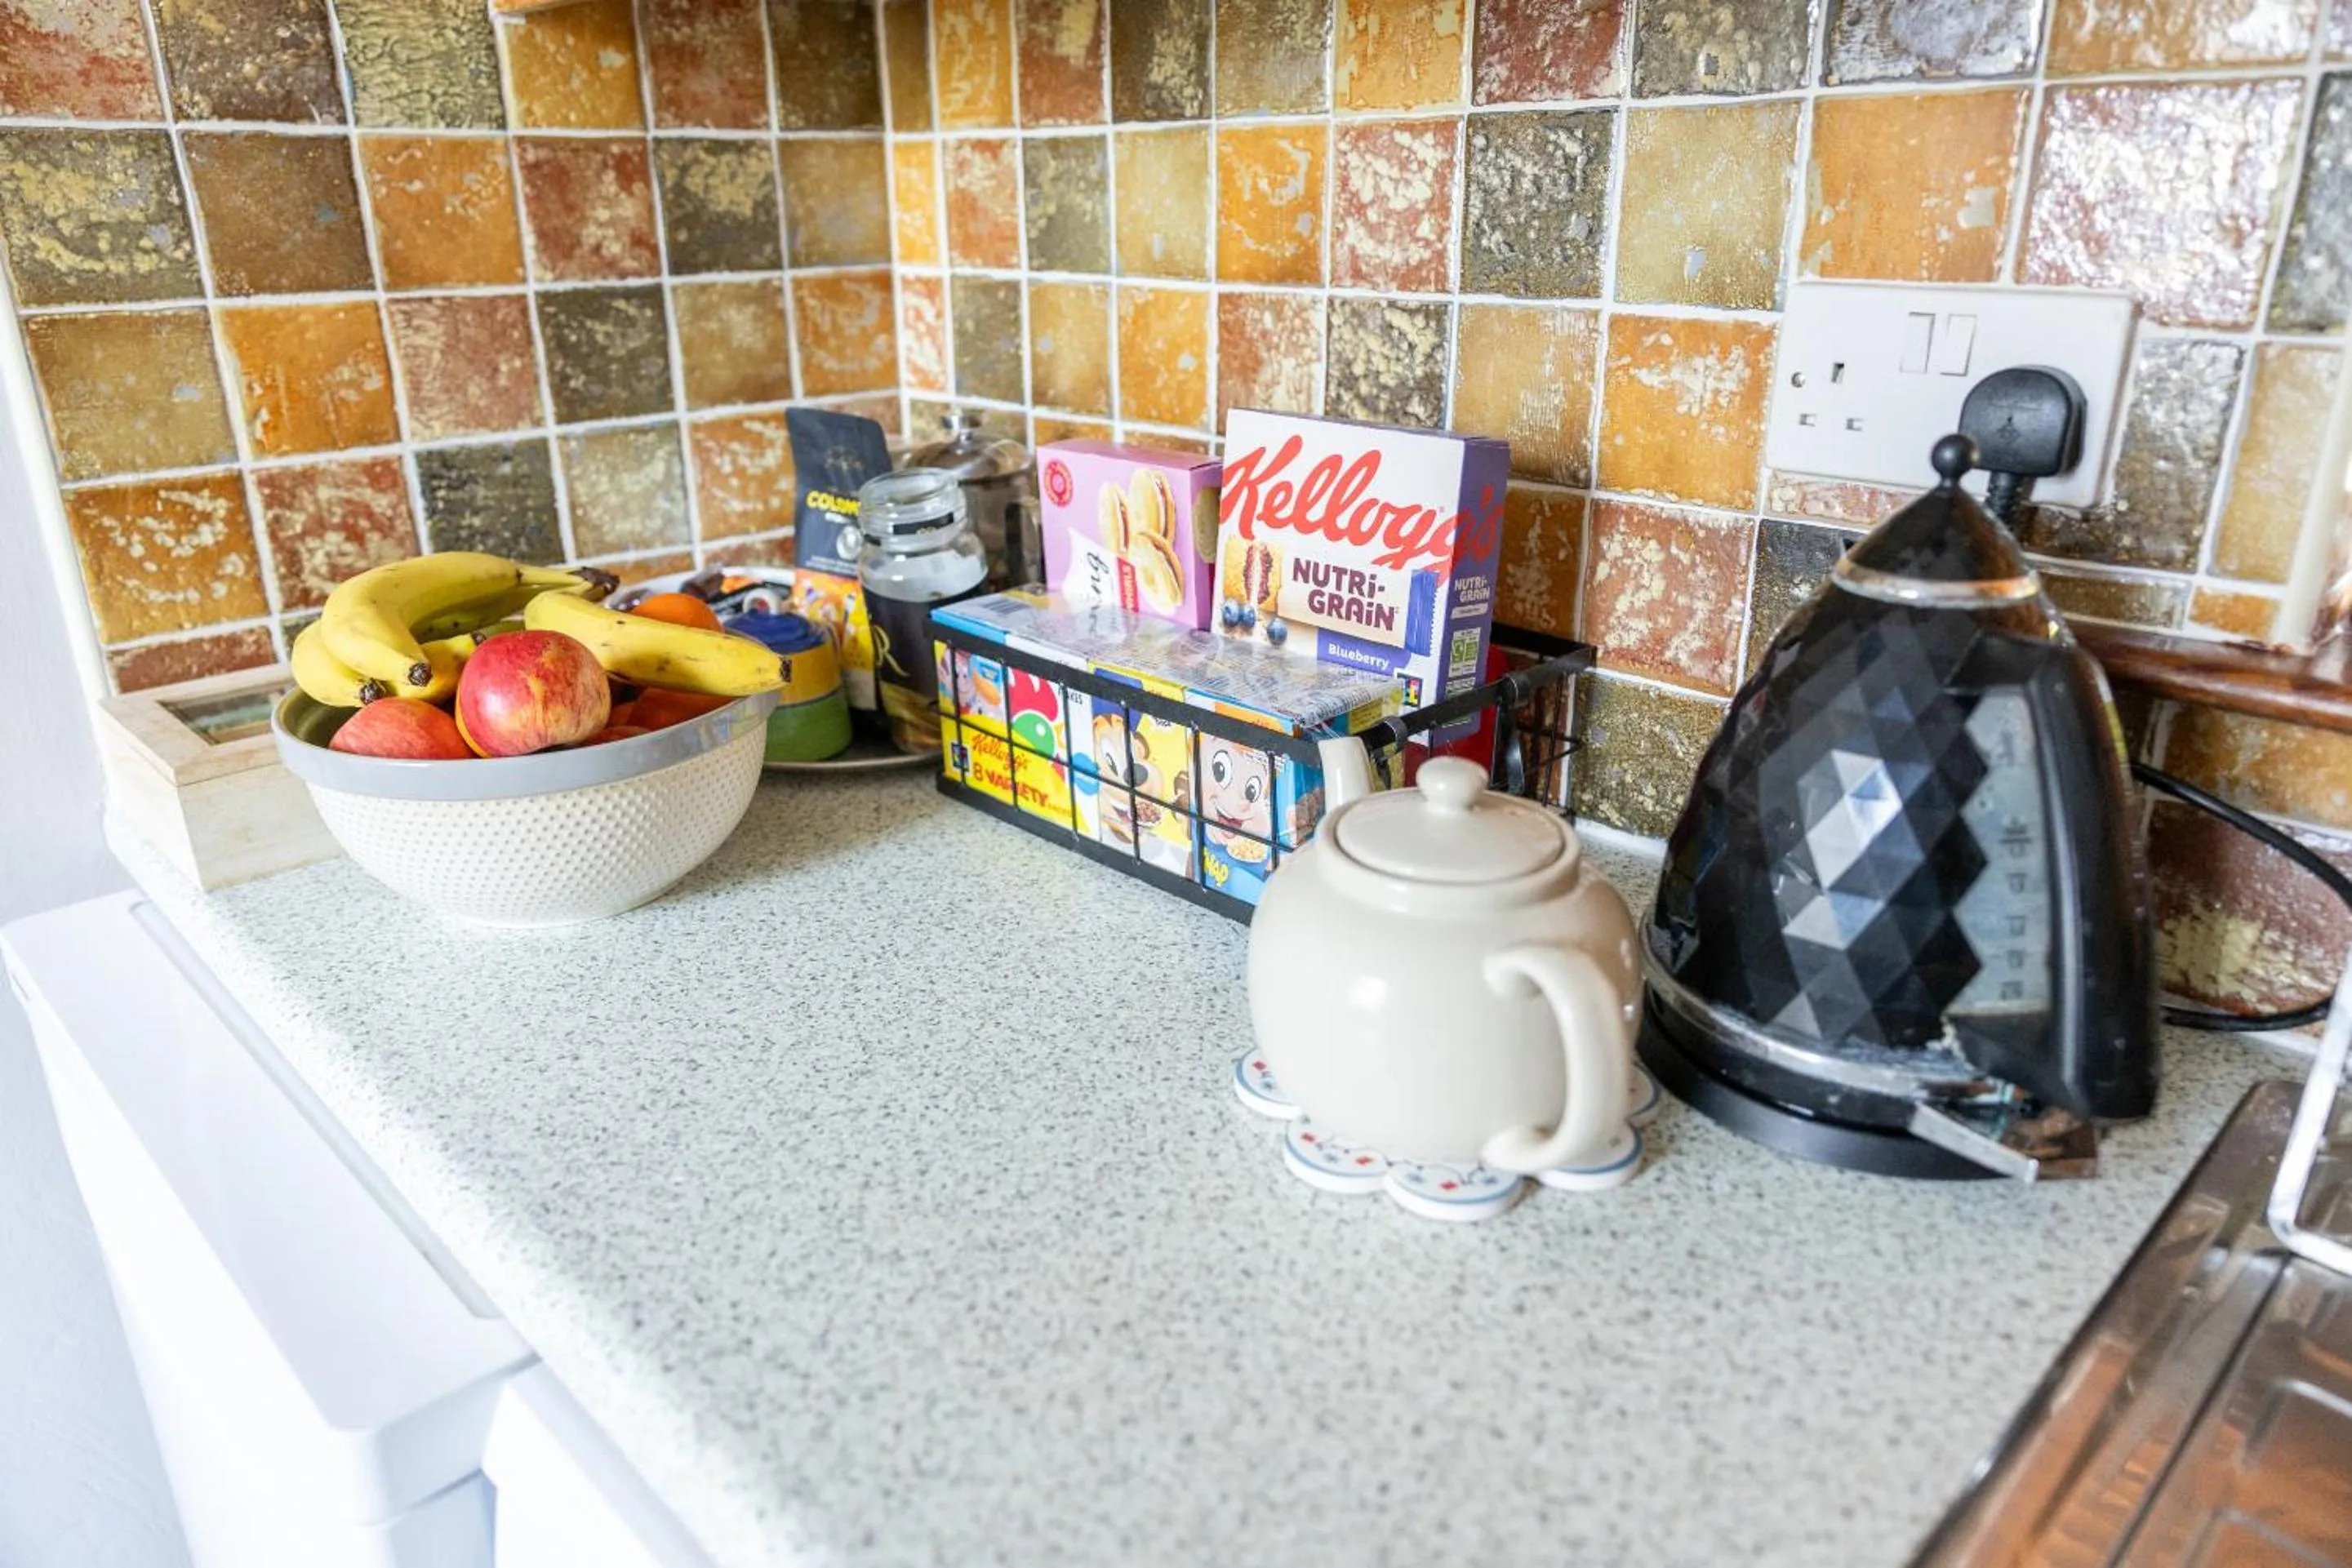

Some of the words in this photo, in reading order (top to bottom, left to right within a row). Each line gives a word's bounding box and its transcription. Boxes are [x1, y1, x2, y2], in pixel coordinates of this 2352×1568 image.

[1220, 434, 1505, 588] Kellogg's
[1327, 642, 1389, 670] Blueberry
[973, 762, 985, 782] 8
